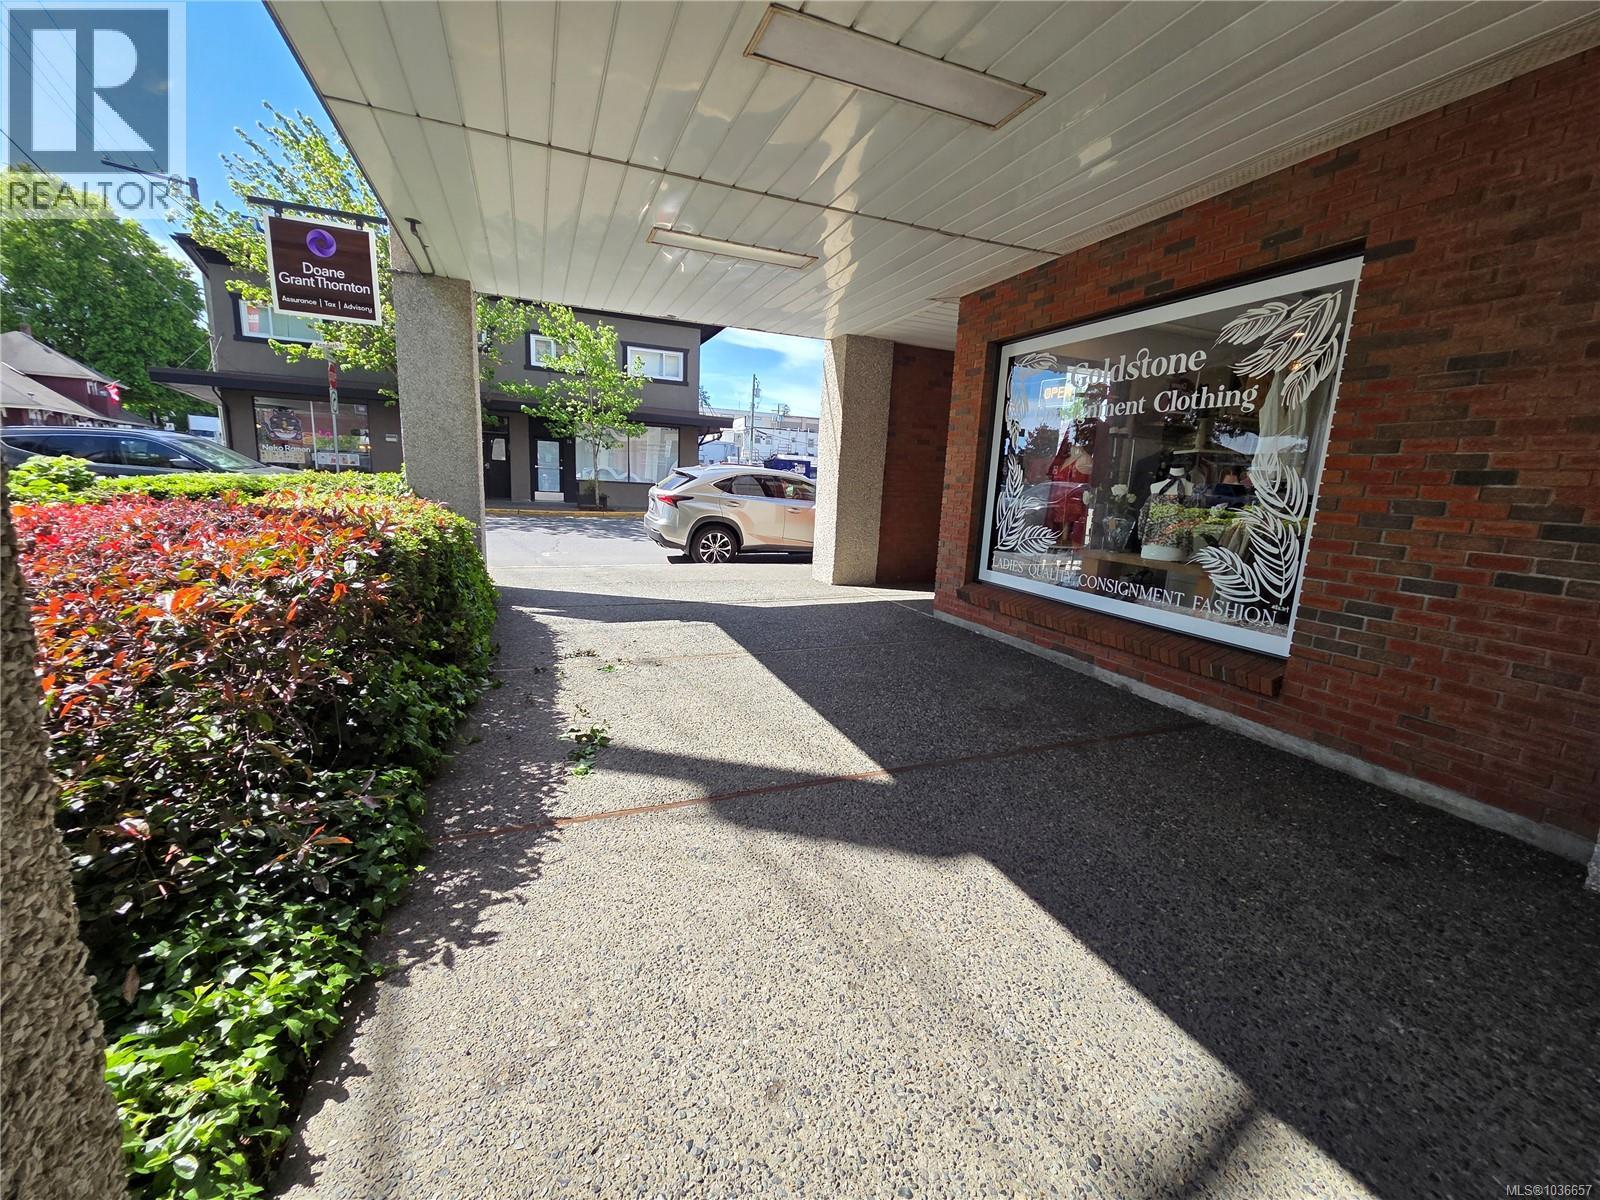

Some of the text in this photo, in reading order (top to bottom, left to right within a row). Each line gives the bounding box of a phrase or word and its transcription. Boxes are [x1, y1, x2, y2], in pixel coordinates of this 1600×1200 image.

[302, 261, 345, 279] Doane
[281, 295, 373, 314] Assurance Tax Advisory
[1071, 348, 1207, 388] Goldstone
[1044, 386, 1073, 400] OPEN
[1153, 384, 1259, 413] Clothing
[261, 444, 311, 453] Neko Ramen
[992, 555, 1024, 574] LADIES
[1078, 573, 1185, 607] CONSIGNMENT
[1192, 595, 1277, 627] FASHION
